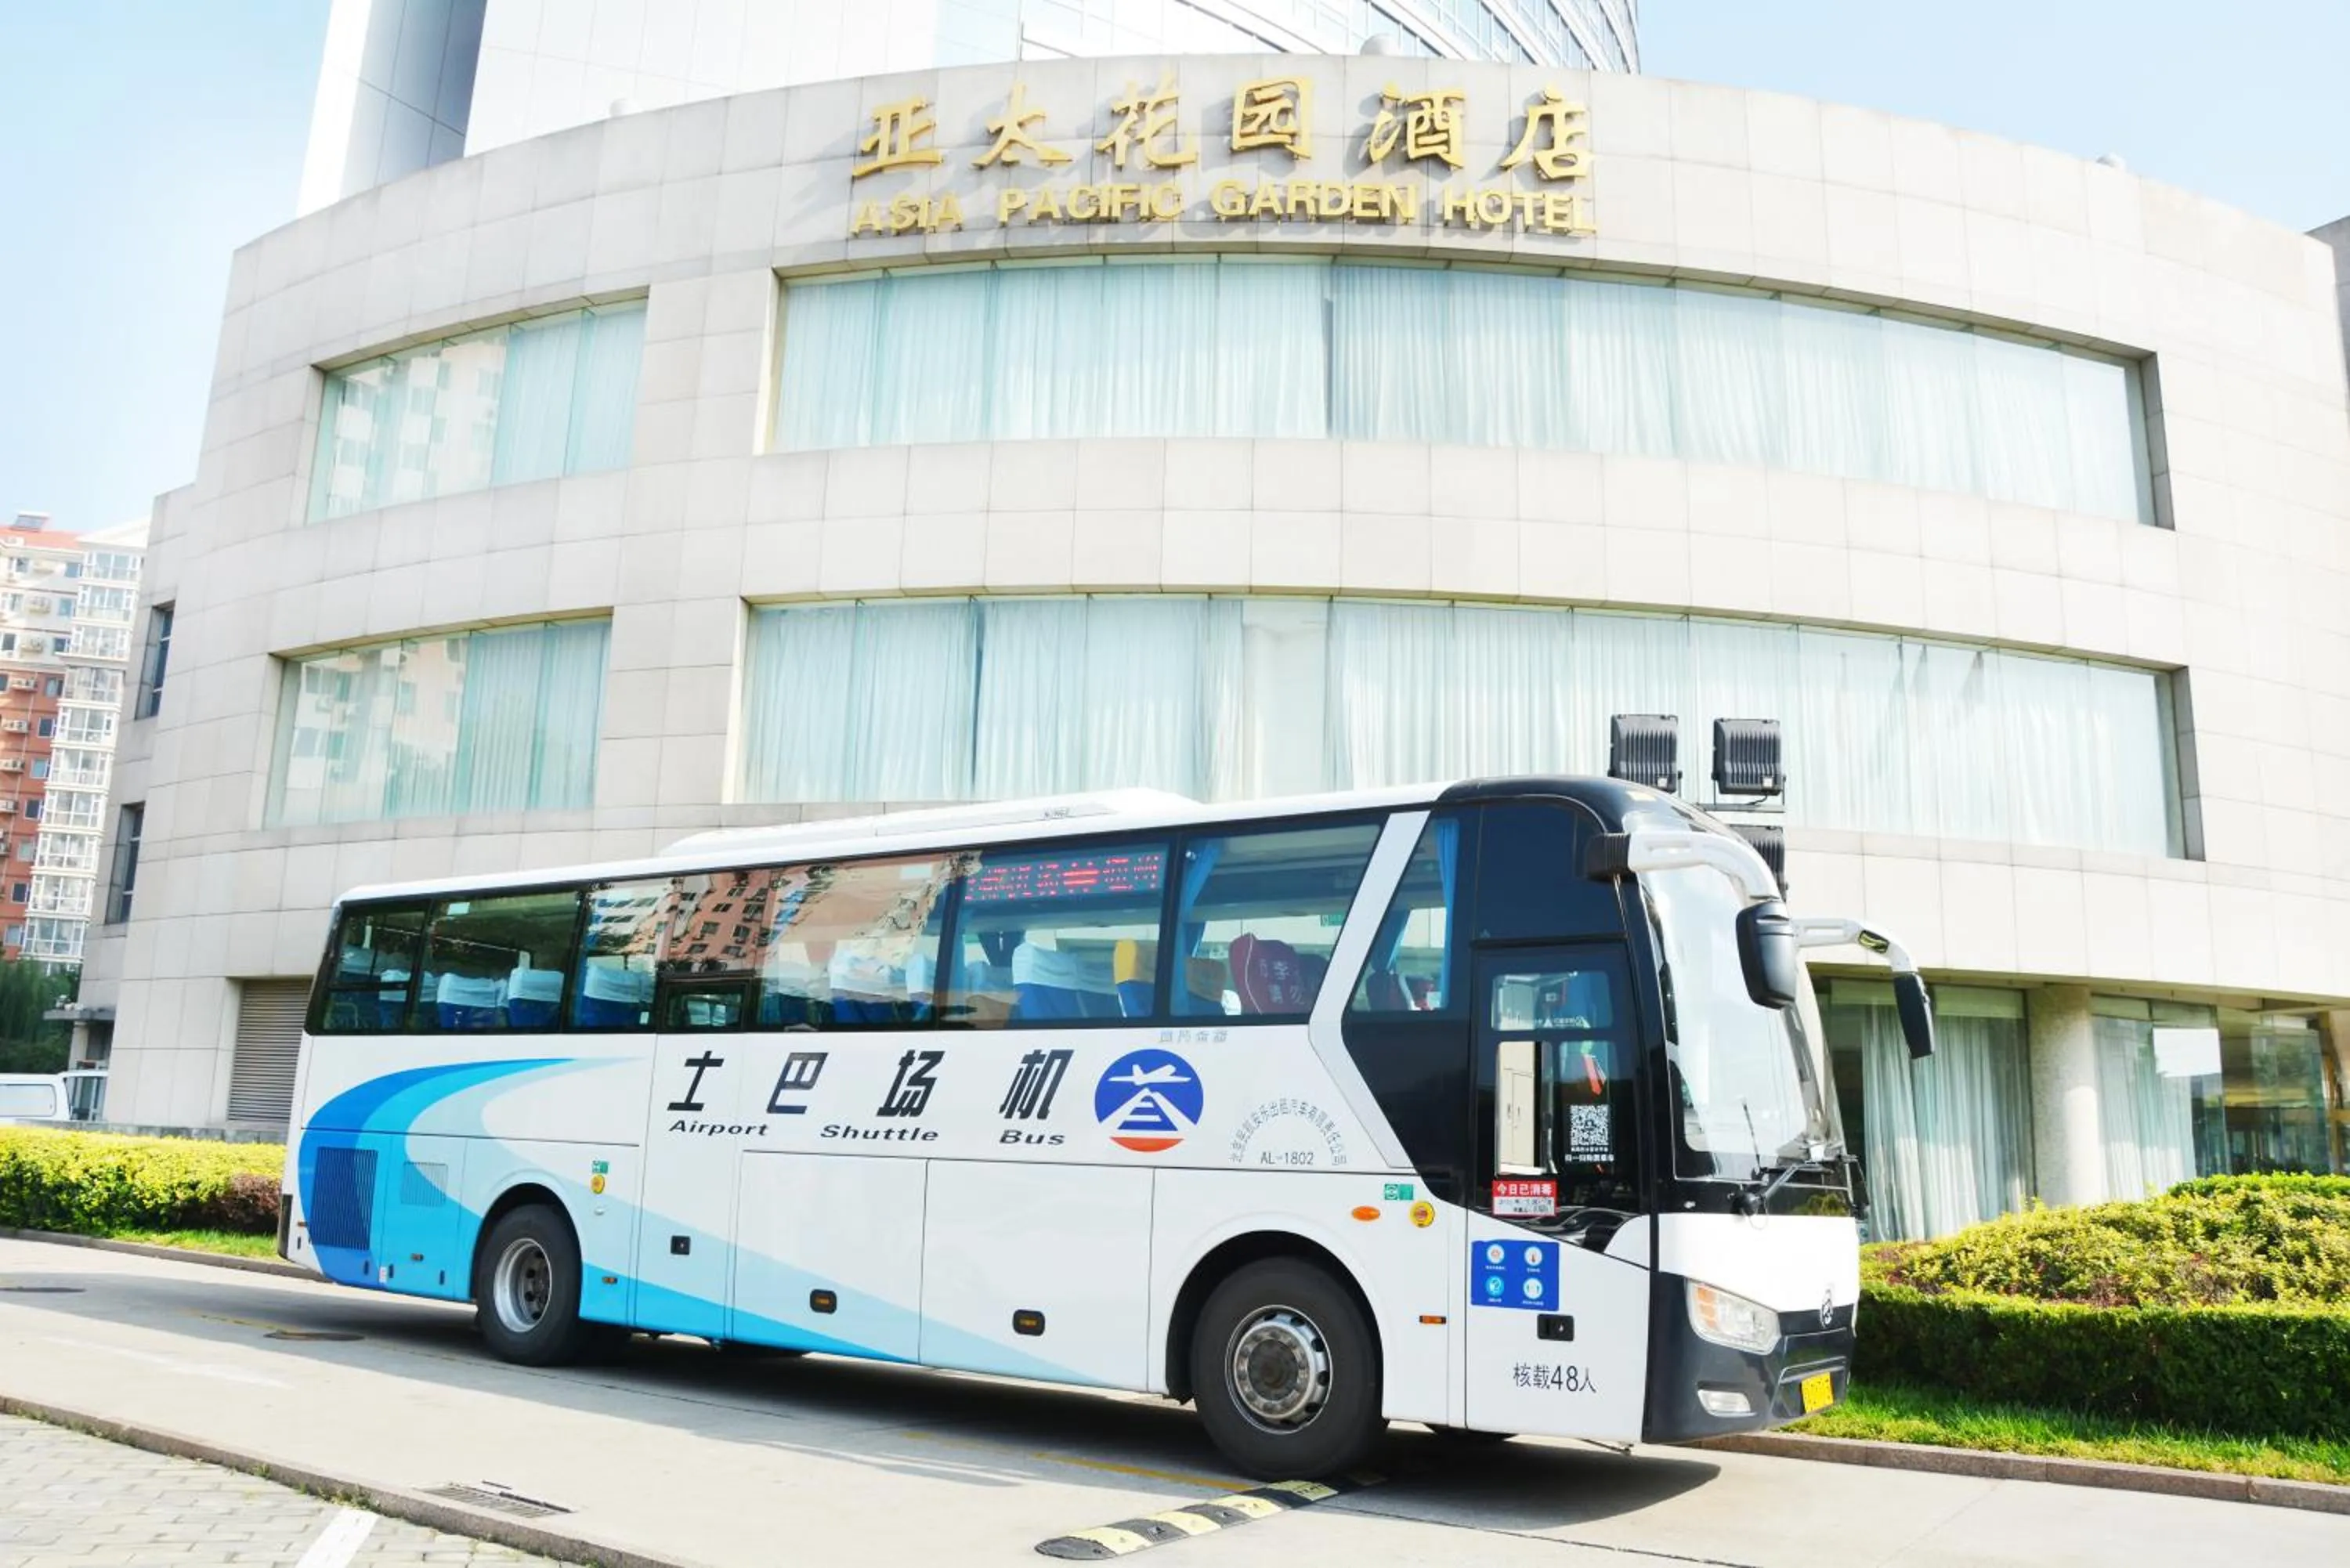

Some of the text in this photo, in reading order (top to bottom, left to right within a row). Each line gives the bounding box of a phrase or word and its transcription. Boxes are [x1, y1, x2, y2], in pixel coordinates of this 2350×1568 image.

[852, 72, 1595, 181] 亚太花园酒店
[851, 179, 1596, 234] ASIA PACIFIC GARDEN HOTEL
[668, 1118, 1065, 1146] Airport Shuttle Bus
[1260, 1151, 1314, 1165] AL-1802
[1497, 1183, 1552, 1196] 今日已消毒
[1513, 1363, 1597, 1393] 核载48人
